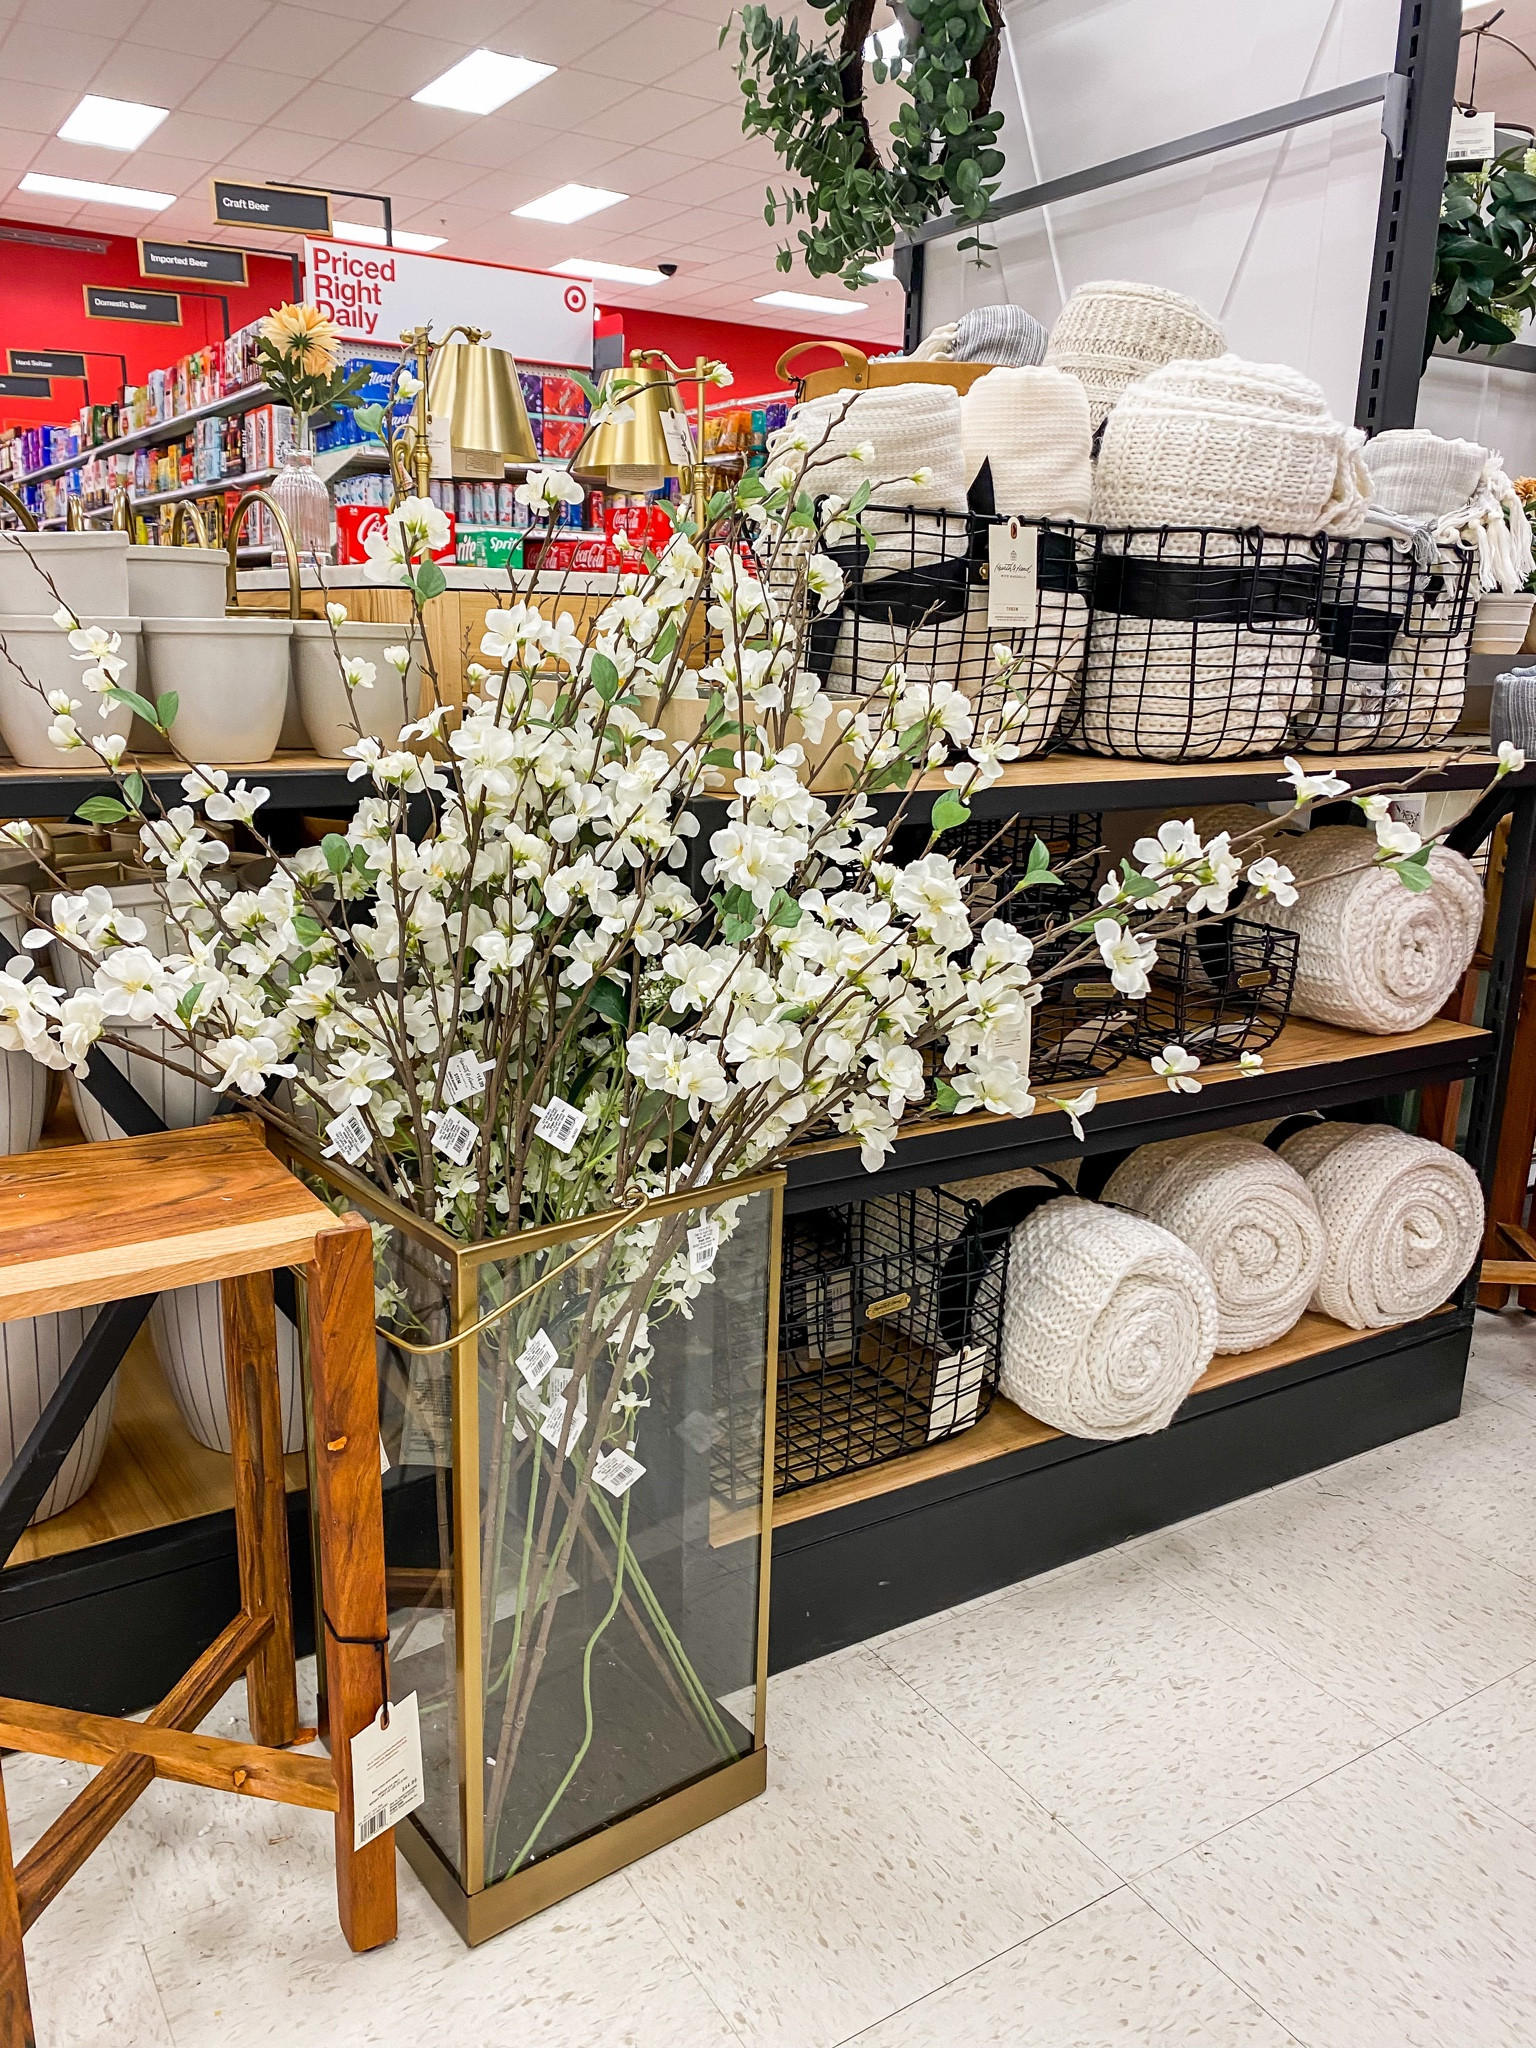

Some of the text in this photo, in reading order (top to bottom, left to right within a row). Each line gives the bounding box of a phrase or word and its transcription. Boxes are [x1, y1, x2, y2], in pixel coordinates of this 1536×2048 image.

[222, 197, 270, 212] Craft Beer
[150, 253, 208, 268] Imported Beer
[313, 247, 395, 282] Priced
[314, 273, 382, 307] Right
[94, 297, 147, 310] Domestic Beer
[315, 299, 379, 335] Daily
[15, 358, 53, 368] Hard Seltzer
[489, 536, 523, 552] Sprite
